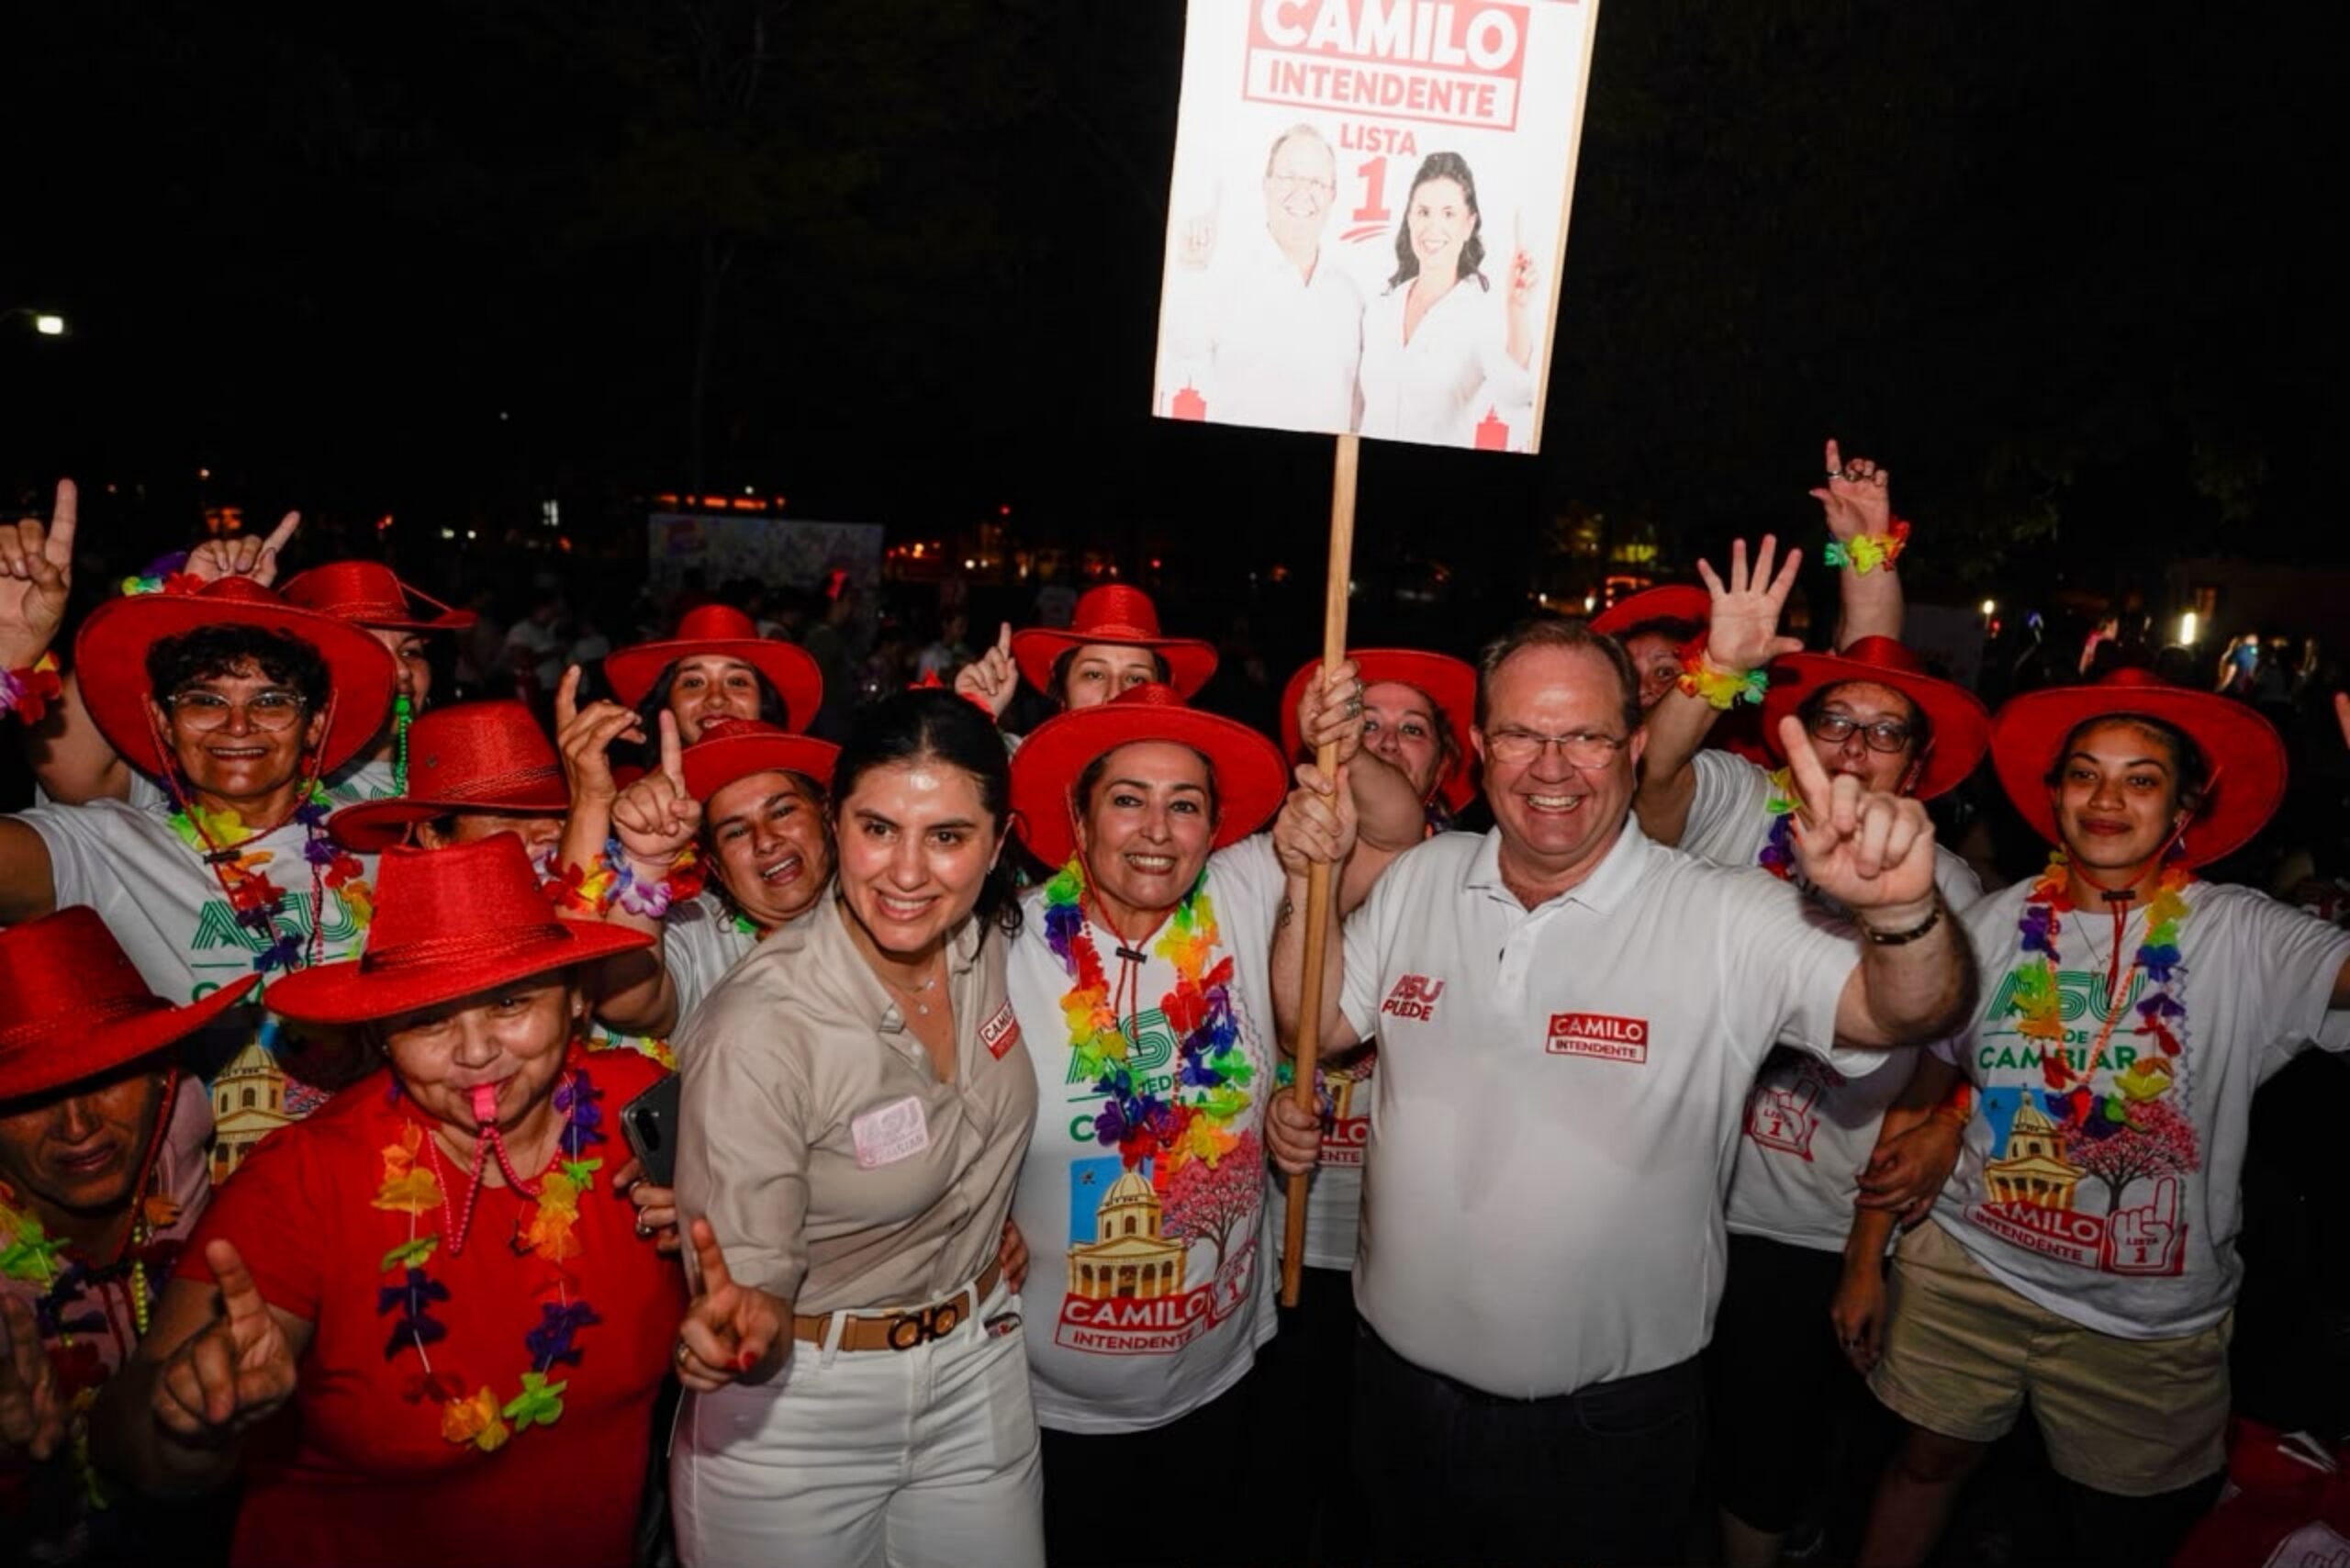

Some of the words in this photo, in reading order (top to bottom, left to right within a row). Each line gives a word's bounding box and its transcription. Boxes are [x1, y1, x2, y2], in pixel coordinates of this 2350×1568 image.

[1260, 0, 1518, 70] CAMILO
[1270, 59, 1497, 118] INTENDENTE
[1339, 123, 1417, 156] LISTA
[1351, 156, 1392, 221] 1
[1389, 974, 1445, 1002] ASU
[1381, 999, 1434, 1022] PUEDE
[1554, 1017, 1643, 1041] CAMILO
[1556, 1039, 1638, 1058] INTENDENTE
[1989, 1203, 2099, 1241] AMILO
[1065, 1290, 1210, 1327] CAMILO
